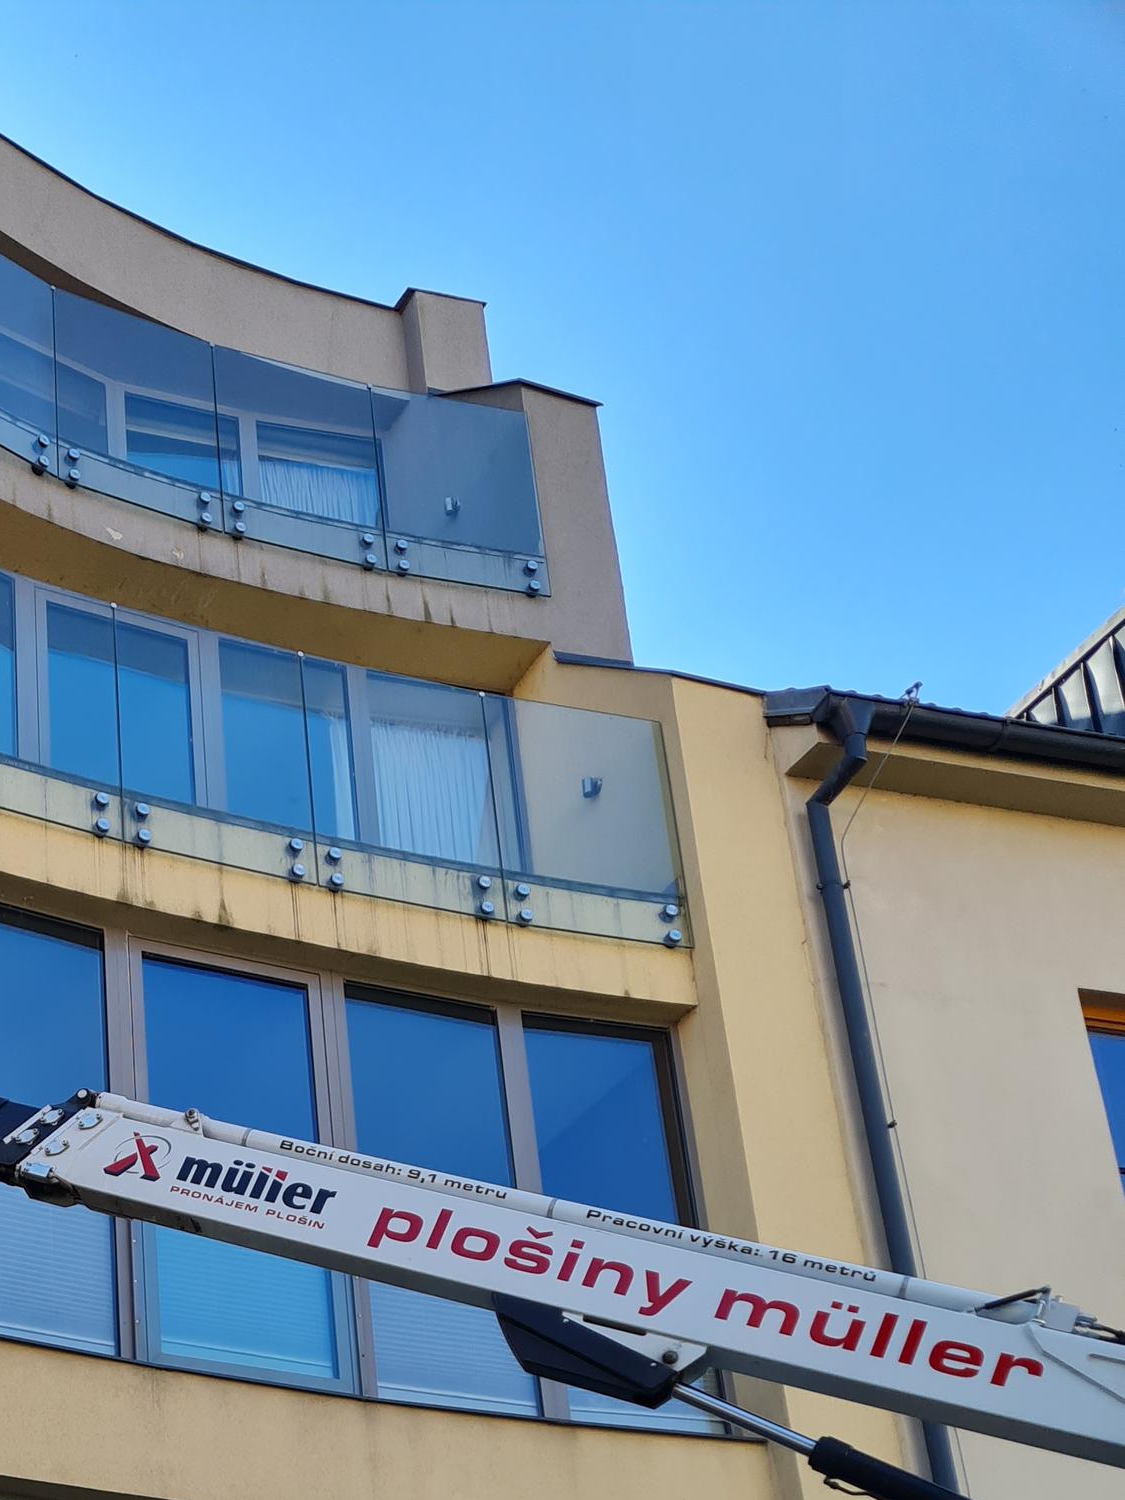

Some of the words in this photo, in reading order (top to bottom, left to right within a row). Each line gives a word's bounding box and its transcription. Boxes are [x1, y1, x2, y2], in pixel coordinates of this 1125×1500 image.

[176, 1155, 338, 1215] müller
[279, 1139, 335, 1162] Boční
[337, 1153, 401, 1176] dosah:
[406, 1168, 437, 1184] 9,1
[443, 1177, 508, 1200] metru
[170, 1185, 259, 1214] PRONÁJEM
[265, 1208, 326, 1230] PLOŠIN
[586, 1208, 683, 1240] Pracovní
[689, 1233, 760, 1257] výška:
[768, 1250, 797, 1264] 16
[366, 1206, 693, 1317] plošiny
[713, 1287, 1045, 1387] müller
